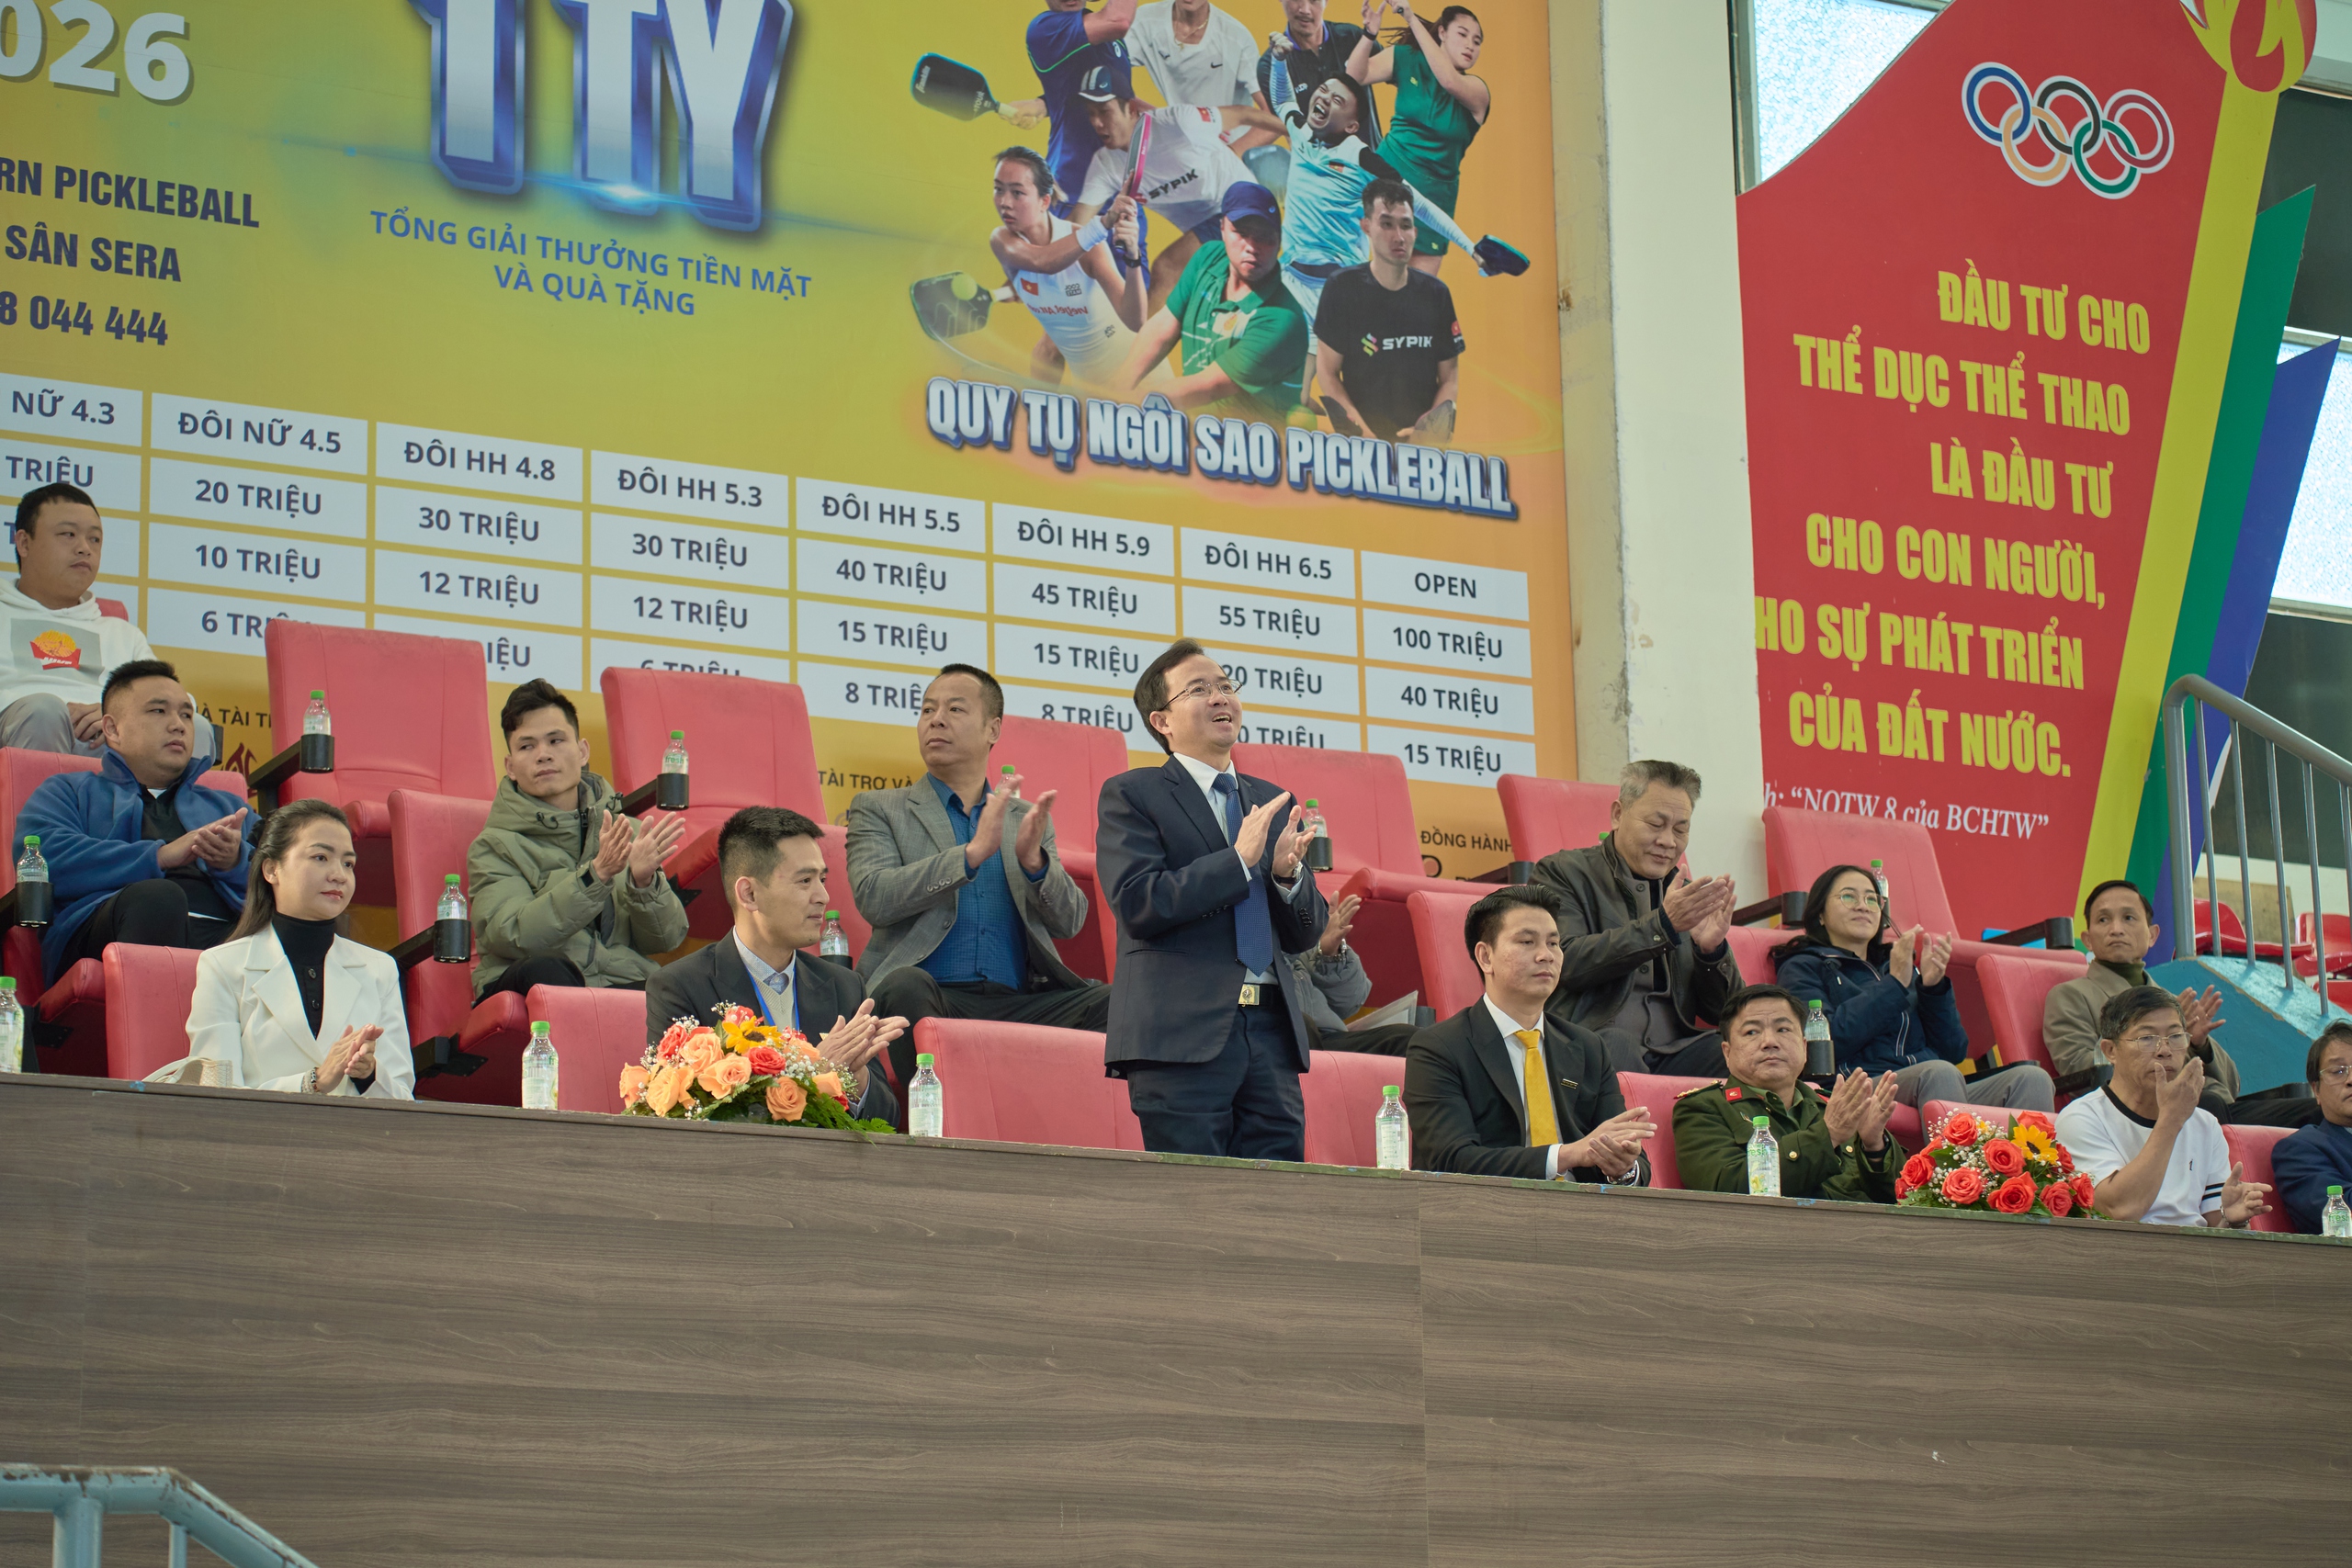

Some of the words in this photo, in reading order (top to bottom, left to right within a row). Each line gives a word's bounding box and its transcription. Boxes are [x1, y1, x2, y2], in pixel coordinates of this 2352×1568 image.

[0, 0, 191, 103] 026
[0, 157, 42, 197] RN
[54, 165, 260, 229] PICKLEBALL
[1148, 169, 1198, 199] SYPIK
[5, 221, 78, 268] SÂN
[89, 236, 182, 282] SERA
[369, 206, 458, 245] TỔNG
[466, 222, 527, 255] GIẢI
[536, 235, 670, 276] THƯỞNG
[677, 253, 741, 288] TIỀN
[751, 265, 812, 301] MẶT
[493, 262, 535, 293] VÀ
[541, 272, 607, 304] QUÀ
[615, 279, 696, 316] TẶNG
[1937, 258, 2010, 331] ĐẦU
[2019, 284, 2068, 341] TƯ
[2078, 294, 2151, 355] CHO
[0, 291, 17, 325] 8
[29, 295, 93, 336] 044
[105, 305, 168, 346] 444
[1382, 336, 1433, 350] SYPIK
[1792, 324, 1863, 394] THỂ
[1873, 345, 1951, 412] DỤC
[1960, 350, 2028, 420] THỂ
[2038, 372, 2131, 435] THAO
[11, 389, 65, 418] NỮ
[71, 397, 116, 425] 4.3
[178, 410, 233, 440] ĐÔI
[243, 418, 293, 447] NỮ
[300, 428, 342, 455] 4.5
[927, 377, 1017, 450] QUY
[1022, 389, 1080, 470] TỤ
[1087, 393, 1190, 473] NGÔI
[1194, 415, 1280, 484] SAO
[1287, 428, 1518, 519] PICKLEBALL
[403, 438, 457, 469] ĐÔI
[467, 449, 507, 476] HH
[515, 457, 556, 481] 4.8
[1929, 436, 1973, 499] LÀ
[1982, 436, 2055, 511] ĐẦU
[2065, 461, 2114, 518] TƯ
[195, 479, 229, 505] 20
[237, 483, 322, 519] TRIỆU
[617, 467, 668, 496] ĐÔI
[677, 477, 717, 503] HH
[724, 482, 763, 507] 5.3
[418, 506, 451, 532] 30
[458, 511, 540, 546] TRIỆU
[821, 492, 870, 523] ĐÔI
[878, 503, 916, 528] HH
[924, 508, 960, 533] 5.5
[631, 533, 663, 558] 30
[670, 536, 748, 570] TRIỆU
[1018, 517, 1063, 547] ĐÔI
[1072, 527, 1108, 552] HH
[1114, 533, 1150, 557] 5.9
[195, 544, 228, 570] 10
[236, 548, 322, 583] TRIỆU
[836, 558, 865, 582] 40
[873, 561, 947, 595] TRIỆU
[1204, 542, 1249, 570] ĐÔI
[1257, 551, 1292, 576] HH
[1298, 557, 1332, 581] 6.5
[1805, 513, 1883, 574] CHO
[1895, 525, 1973, 586] CON
[1984, 538, 2105, 610] NGƯỜI,
[419, 570, 451, 595] 12
[458, 574, 540, 608] TRIỆU
[1031, 582, 1059, 605] 45
[1067, 585, 1138, 618] TRIỆU
[1414, 571, 1478, 599] OPEN
[201, 610, 219, 633] 6
[632, 595, 663, 620] 12
[670, 599, 749, 632] TRIỆU
[1218, 604, 1247, 627] 55
[1252, 608, 1321, 639] TRIỆU
[487, 637, 530, 671] IỆU
[837, 619, 866, 643] 15
[874, 622, 948, 656] TRIỆU
[1392, 626, 1431, 650] 100
[1437, 630, 1503, 662] TRIỆU
[1755, 596, 1805, 654] HO
[1816, 603, 1871, 671] SỰ
[1880, 611, 1973, 676] PHÁT
[1979, 616, 2084, 690] TRIỂN
[1033, 642, 1061, 665] 15
[1068, 645, 1139, 678] TRIỆU
[845, 682, 859, 704] 8
[866, 682, 922, 716] TRIỆ
[1254, 667, 1322, 698] TRIỆU
[219, 706, 249, 727] TÀI
[1400, 685, 1427, 707] 40
[1433, 687, 1498, 719] TRIỆU
[1789, 682, 1868, 753] CỦA
[1876, 689, 1949, 762] ĐẤT
[1960, 710, 2071, 778] NƯỚC.
[818, 768, 843, 787] TÀI
[1404, 743, 1430, 765] 15
[1435, 745, 1502, 777] TRIỆU
[1884, 796, 1897, 820] 8
[1903, 799, 1939, 829] của
[1420, 826, 1466, 848] ĐỒNG
[1472, 833, 1513, 852] HÀNH
